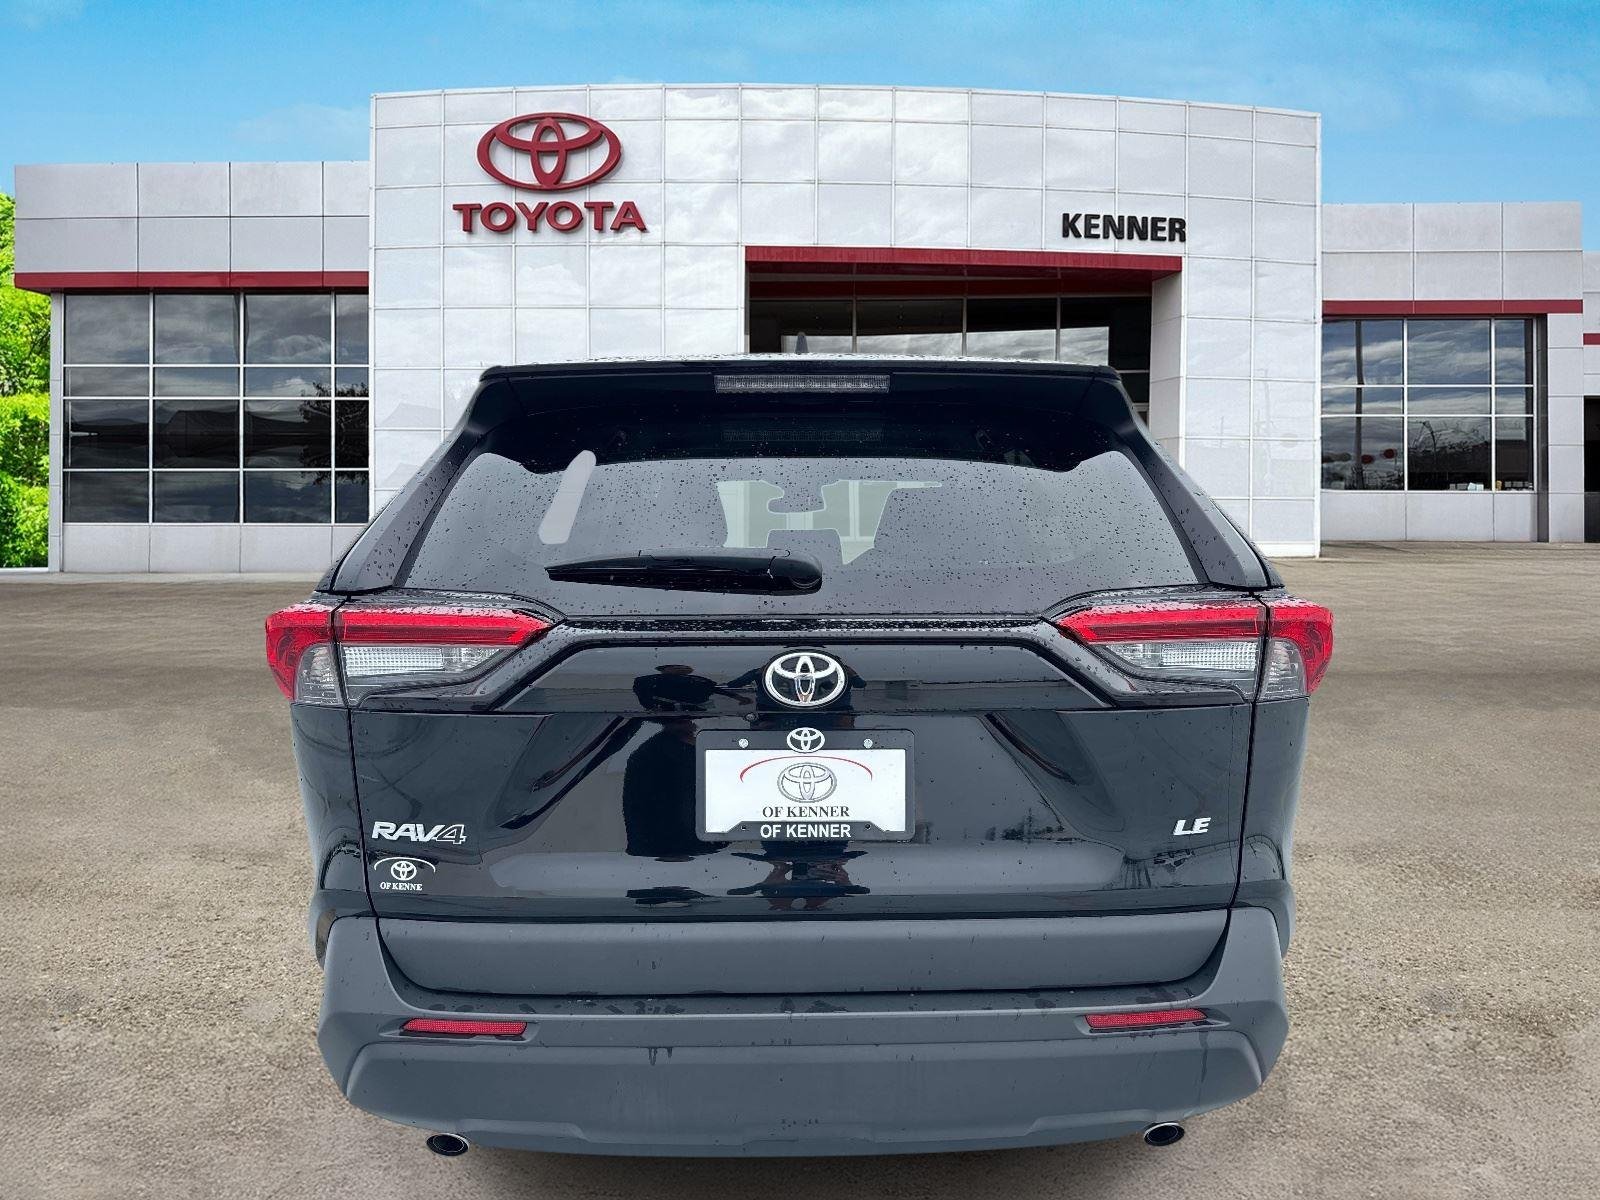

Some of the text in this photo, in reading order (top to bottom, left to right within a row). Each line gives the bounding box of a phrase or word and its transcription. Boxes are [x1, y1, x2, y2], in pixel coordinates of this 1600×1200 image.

[453, 201, 647, 232] TOYOTA
[1062, 213, 1187, 242] KENNER
[762, 806, 850, 818] OF KENNER
[371, 821, 467, 845] RAV4
[760, 824, 851, 838] OF KENNER
[1173, 817, 1211, 836] LE
